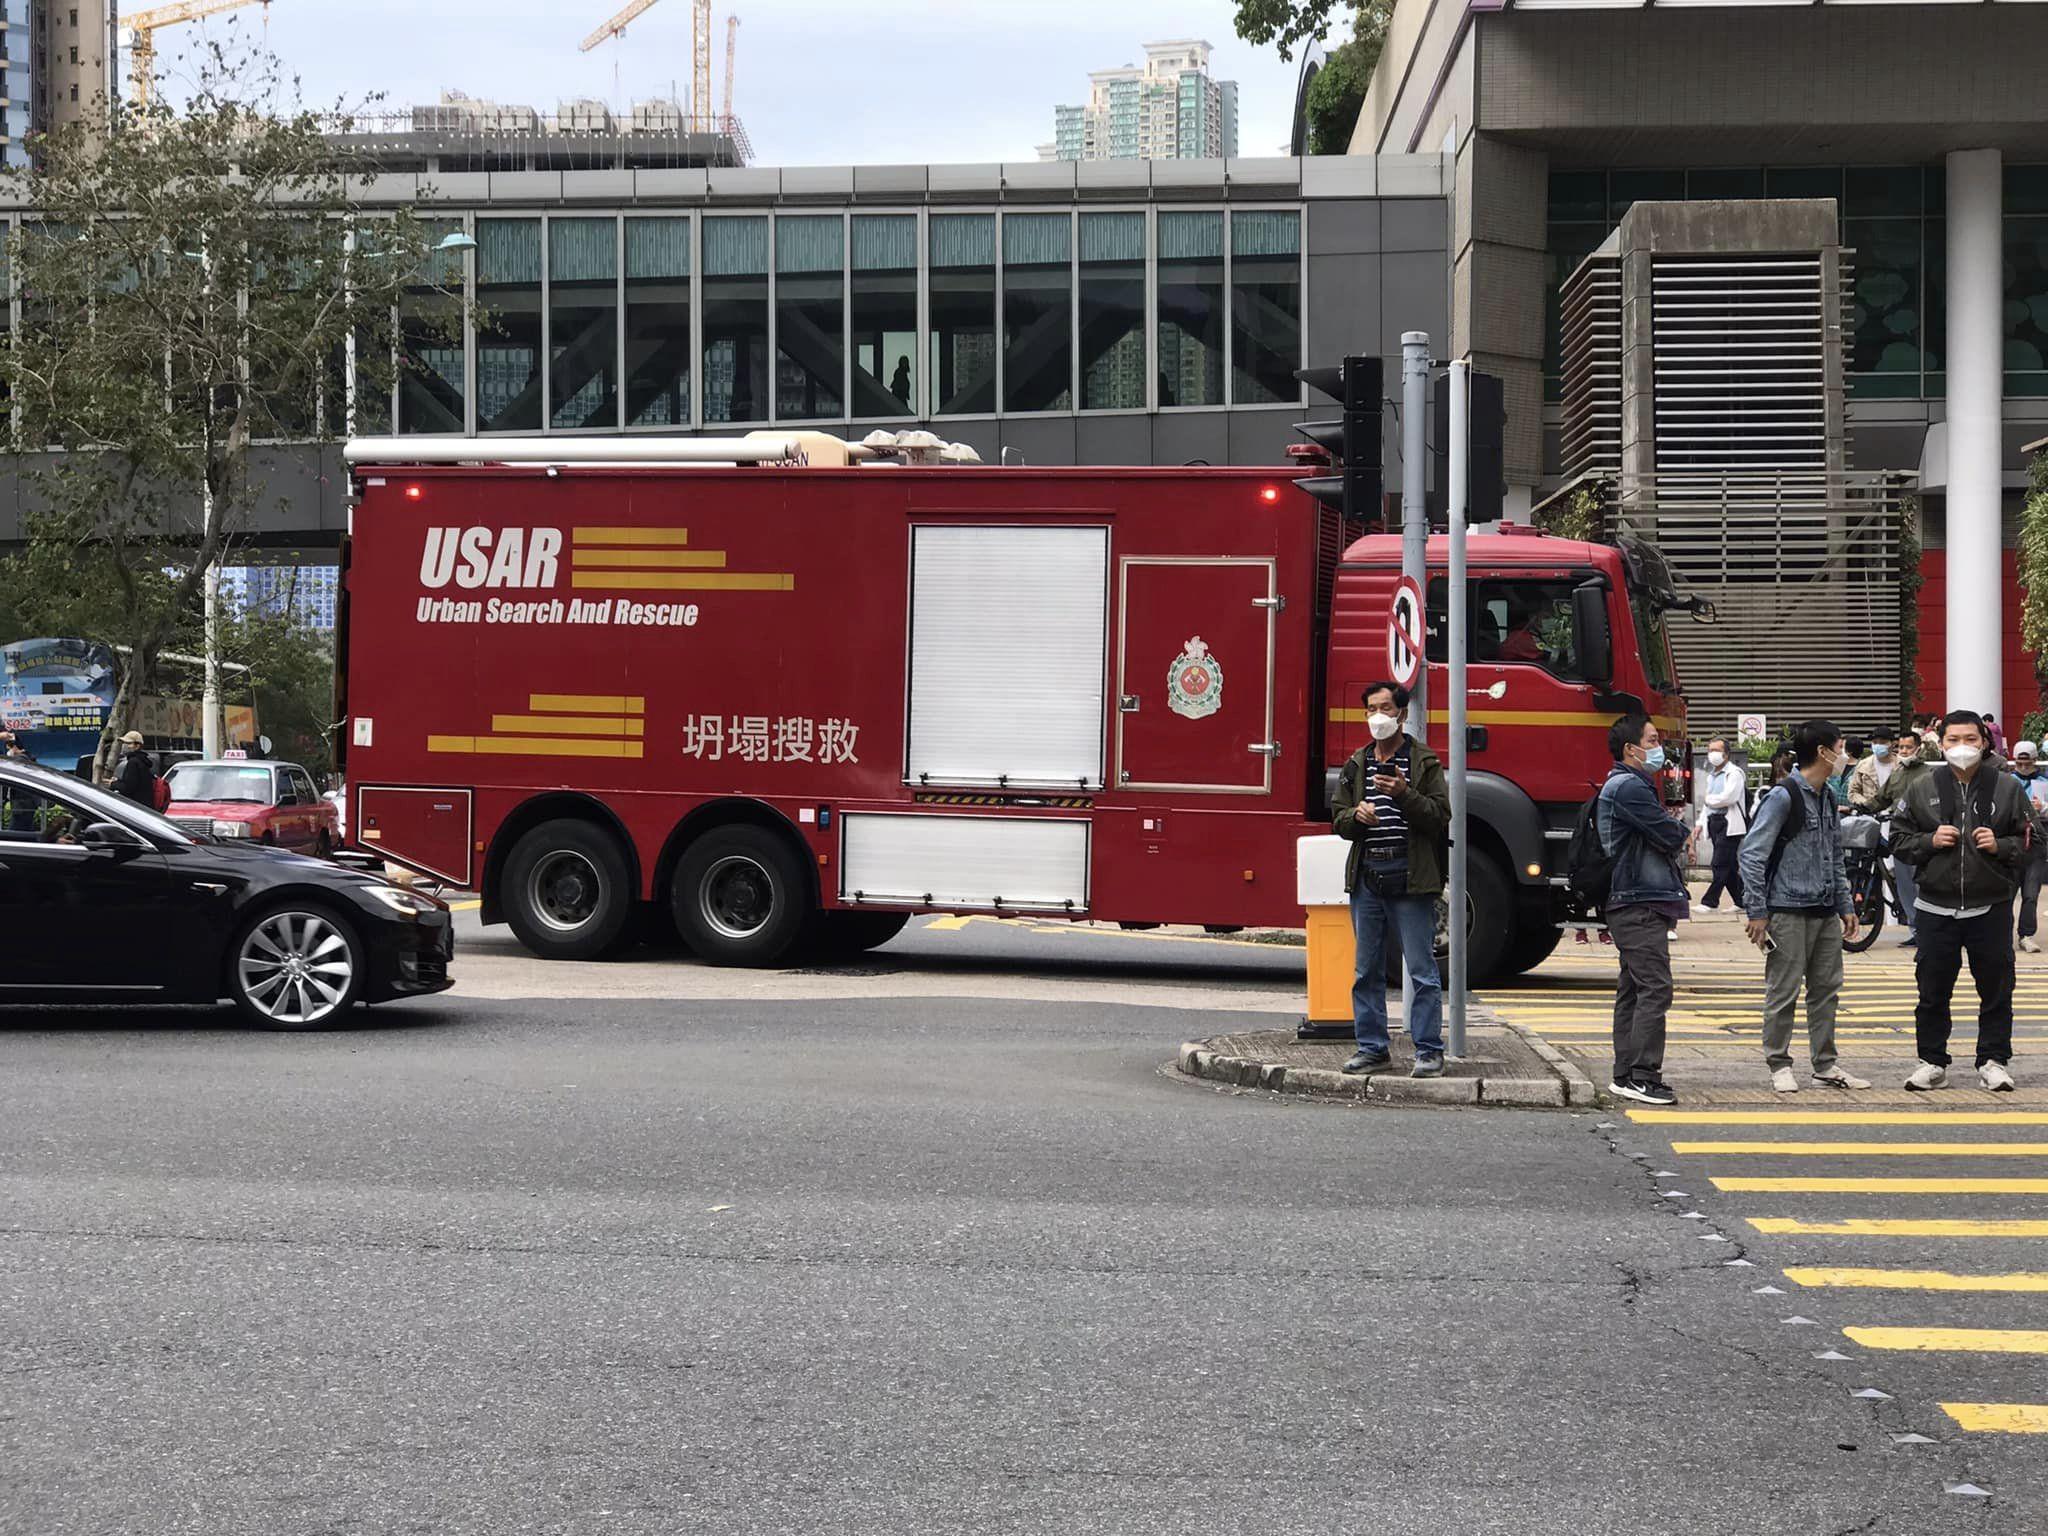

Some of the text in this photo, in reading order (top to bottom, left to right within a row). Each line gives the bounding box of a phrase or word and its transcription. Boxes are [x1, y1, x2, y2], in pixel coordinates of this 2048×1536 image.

[419, 526, 563, 589] USAR
[416, 597, 699, 626] Urban Search And Rescue
[682, 713, 860, 764] 坍塌搜救
